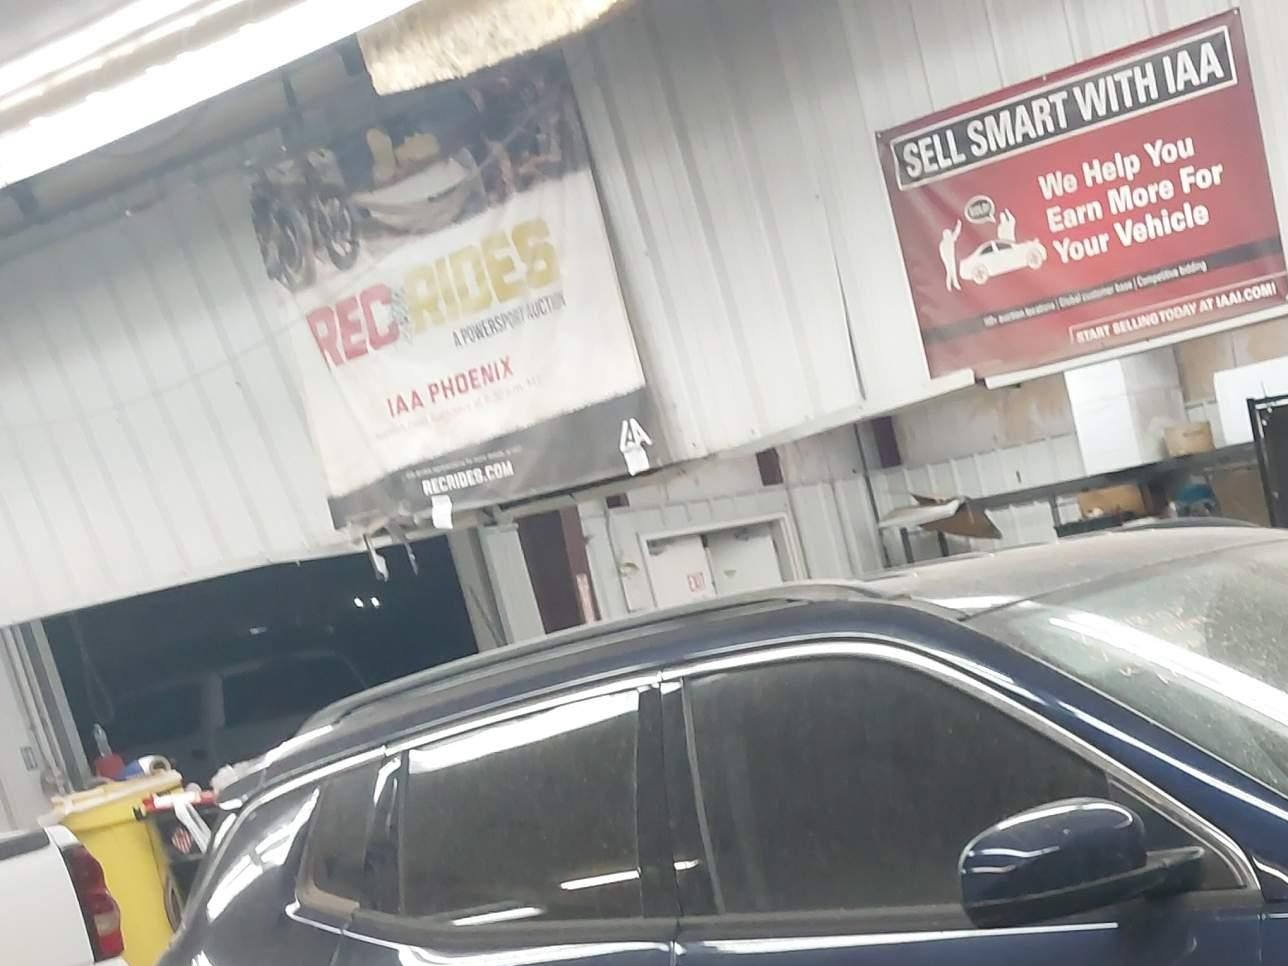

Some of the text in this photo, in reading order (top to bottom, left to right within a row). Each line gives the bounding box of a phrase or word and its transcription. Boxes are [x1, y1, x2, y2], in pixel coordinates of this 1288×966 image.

[902, 41, 1225, 178] SELL SMART WITH IAA
[1038, 137, 1196, 201] We Help You
[1046, 164, 1224, 233] Earn More For
[1052, 202, 1210, 264] Your Vehicle
[526, 291, 568, 321] AUCTN
[1075, 324, 1110, 344] START
[1111, 312, 1159, 335] SELLING
[1159, 303, 1197, 325] TODAY
[1199, 298, 1214, 313] AT
[387, 389, 425, 419] IAA
[427, 355, 515, 404] PHOENIX
